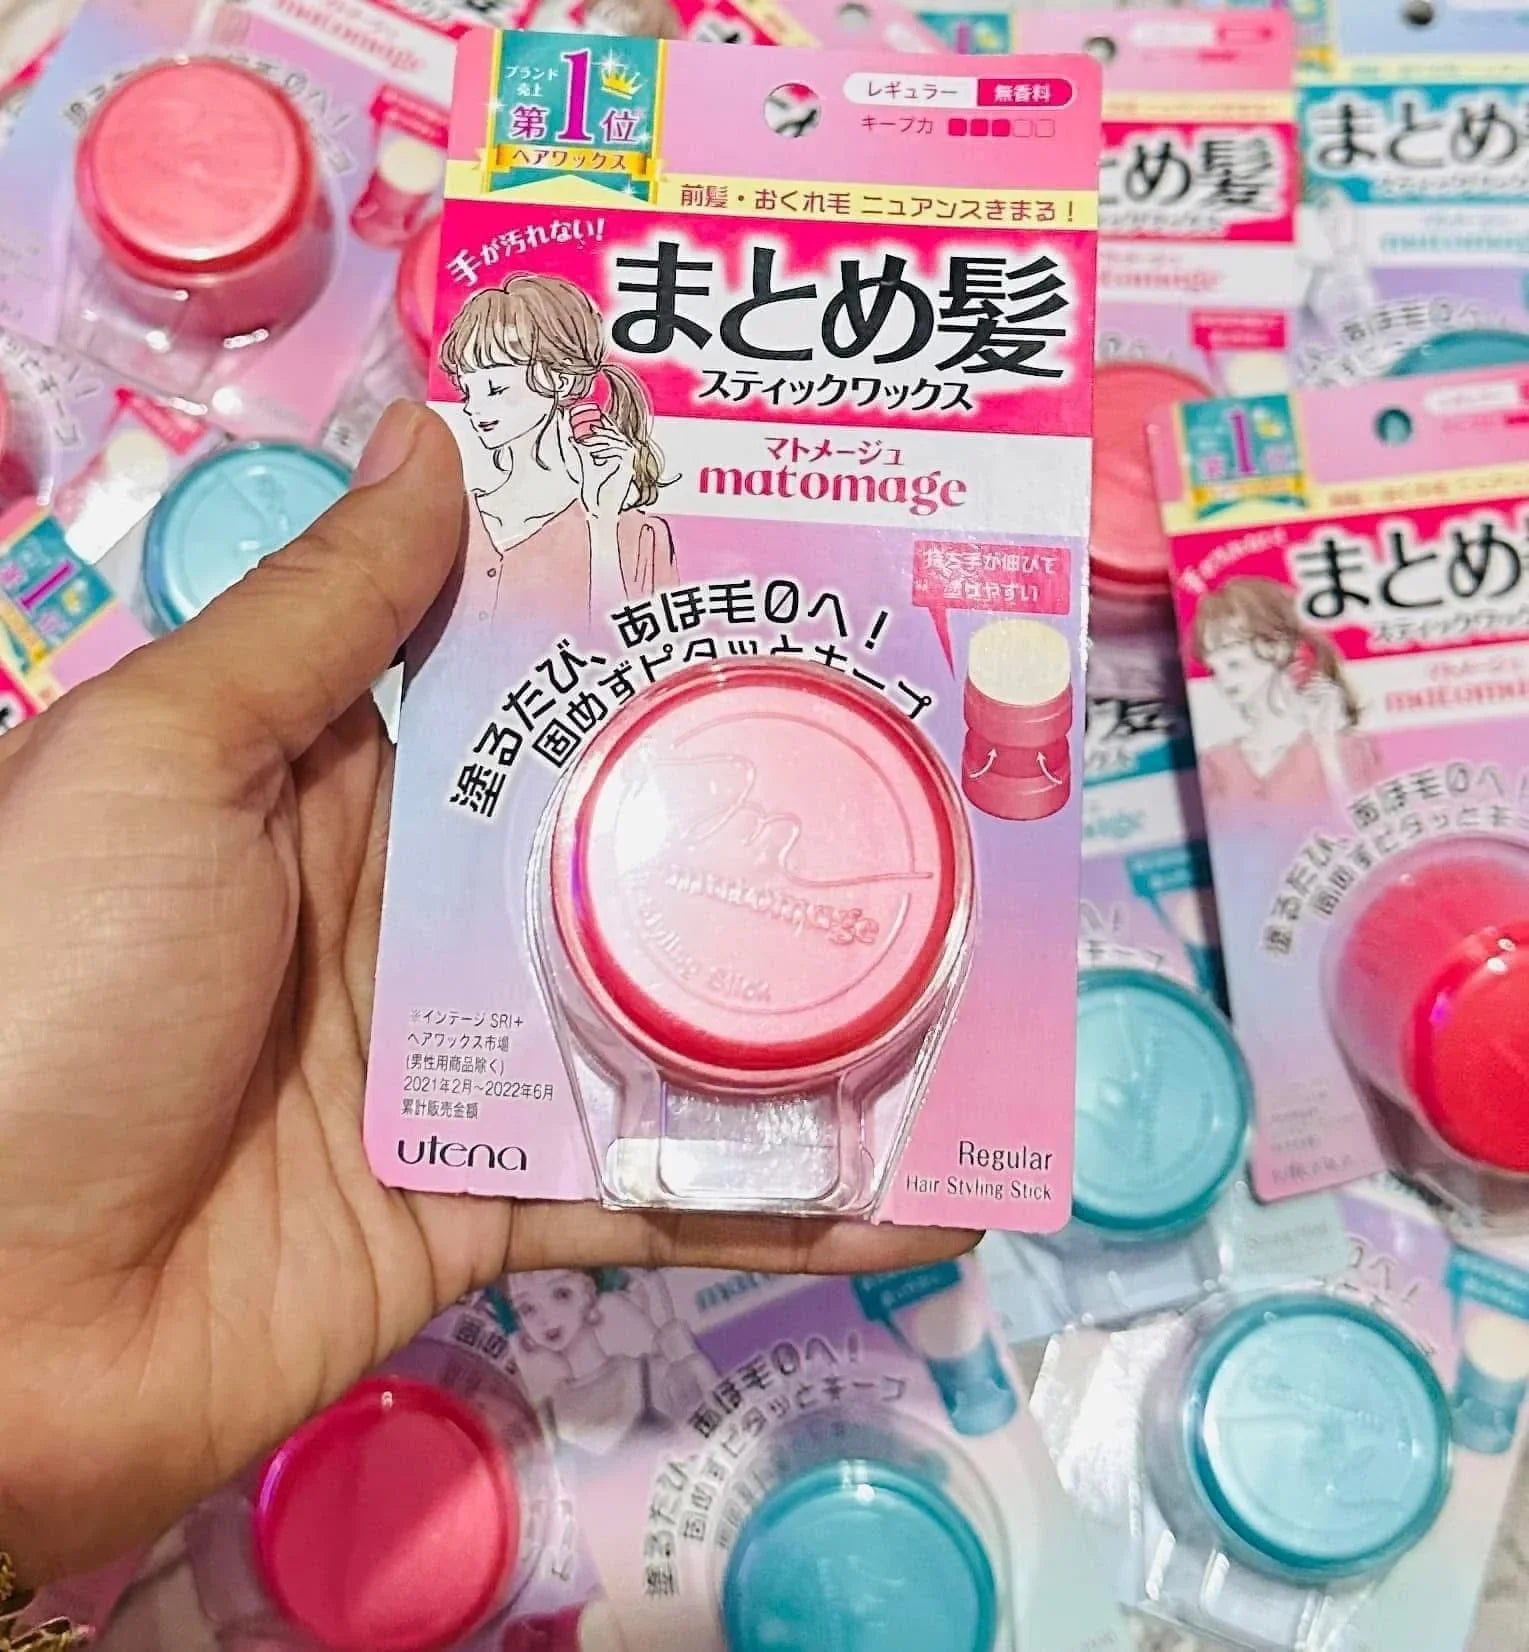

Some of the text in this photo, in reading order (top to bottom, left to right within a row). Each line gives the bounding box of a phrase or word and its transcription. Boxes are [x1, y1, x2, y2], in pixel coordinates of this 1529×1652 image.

[505, 65, 559, 82] ブランド
[867, 80, 1052, 103] レギュラー 無香料
[1312, 100, 1529, 170] まとめ
[513, 148, 627, 170] ヘアワックス
[1099, 138, 1274, 212] め髪
[680, 183, 852, 215] 前髪・おくれ毛
[610, 240, 1068, 379] まとめ髪
[698, 369, 974, 412] スティックワックス
[763, 436, 904, 466] マトメージュ
[699, 465, 967, 516] matomage
[1294, 520, 1529, 622] まとめ
[397, 1136, 528, 1171] utena
[958, 1140, 1053, 1171] Regular
[906, 1175, 1052, 1201] Hair Styling Stick
